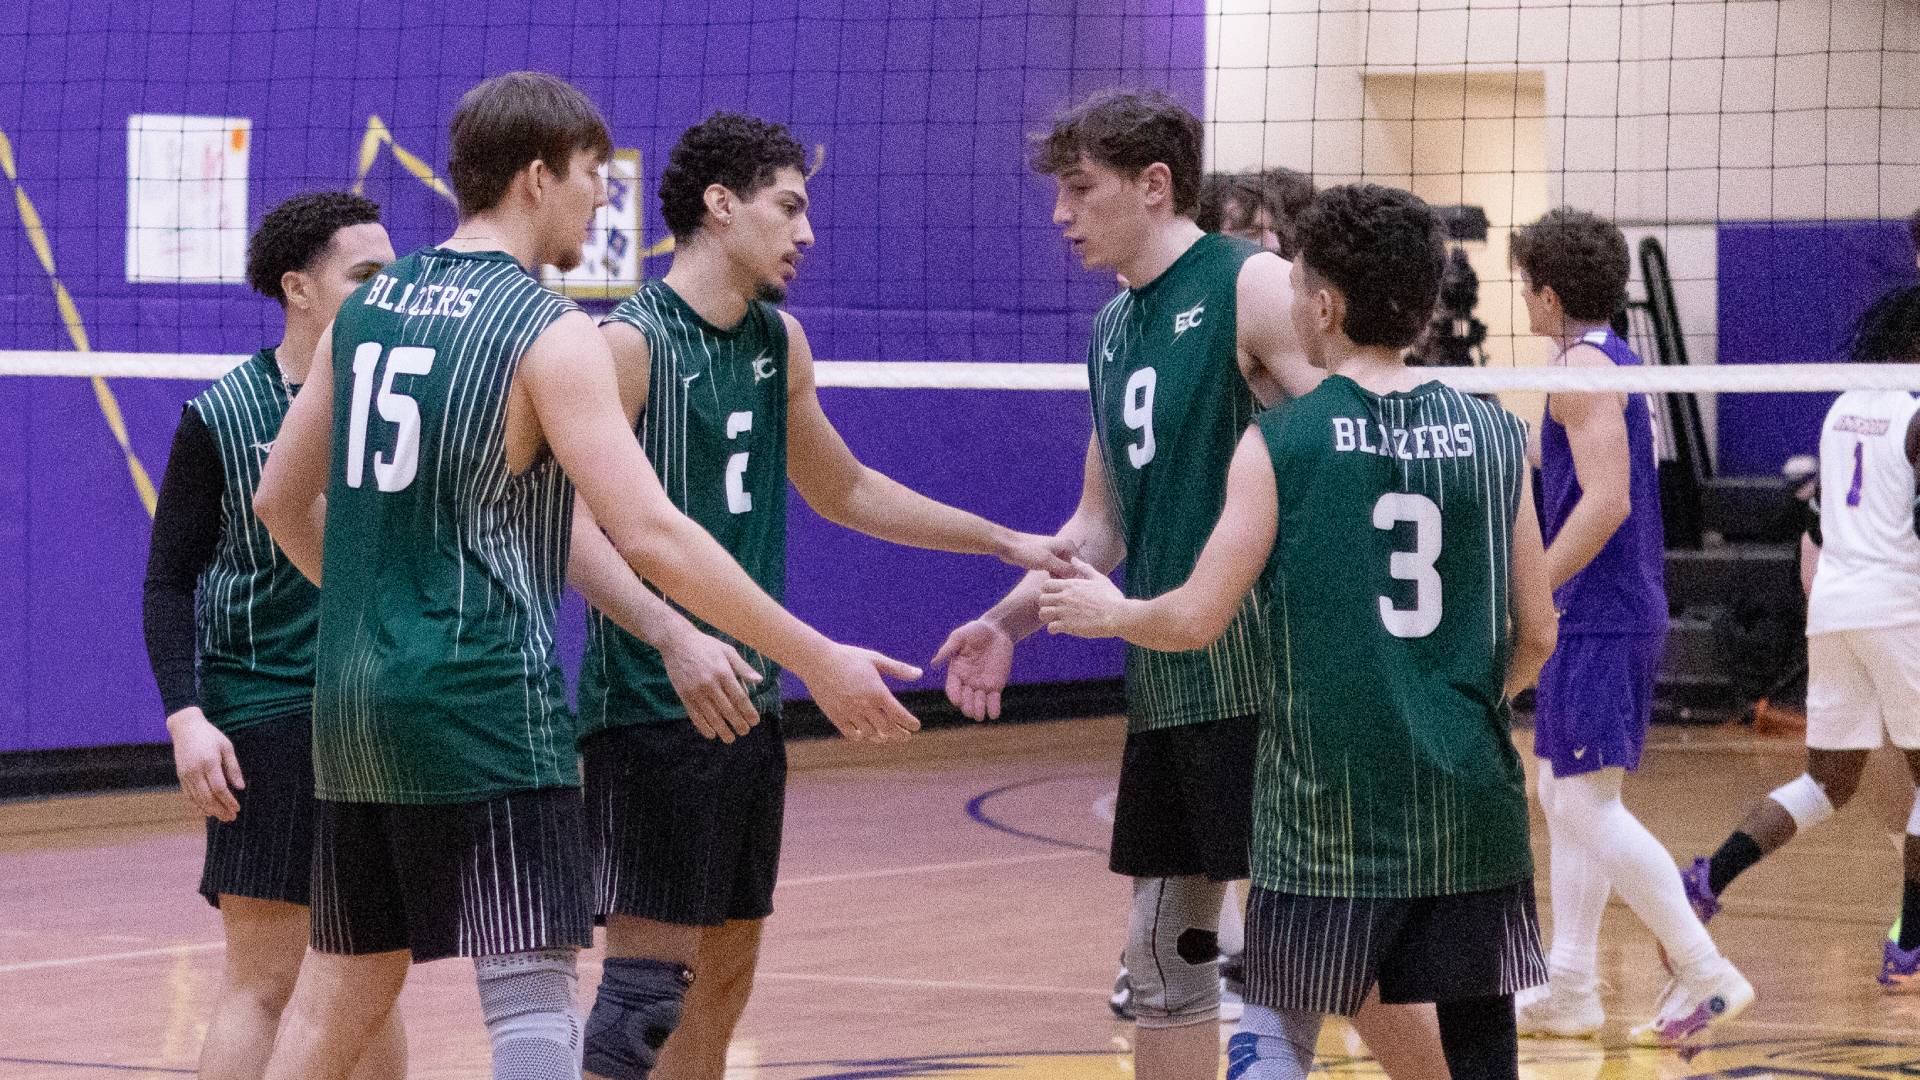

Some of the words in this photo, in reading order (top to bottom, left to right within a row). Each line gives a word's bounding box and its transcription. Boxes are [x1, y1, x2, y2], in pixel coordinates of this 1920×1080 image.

[1174, 306, 1205, 335] EC
[346, 341, 436, 493] 15
[1123, 366, 1157, 470] 9
[1846, 441, 1864, 507] 1
[1372, 492, 1443, 638] 3
